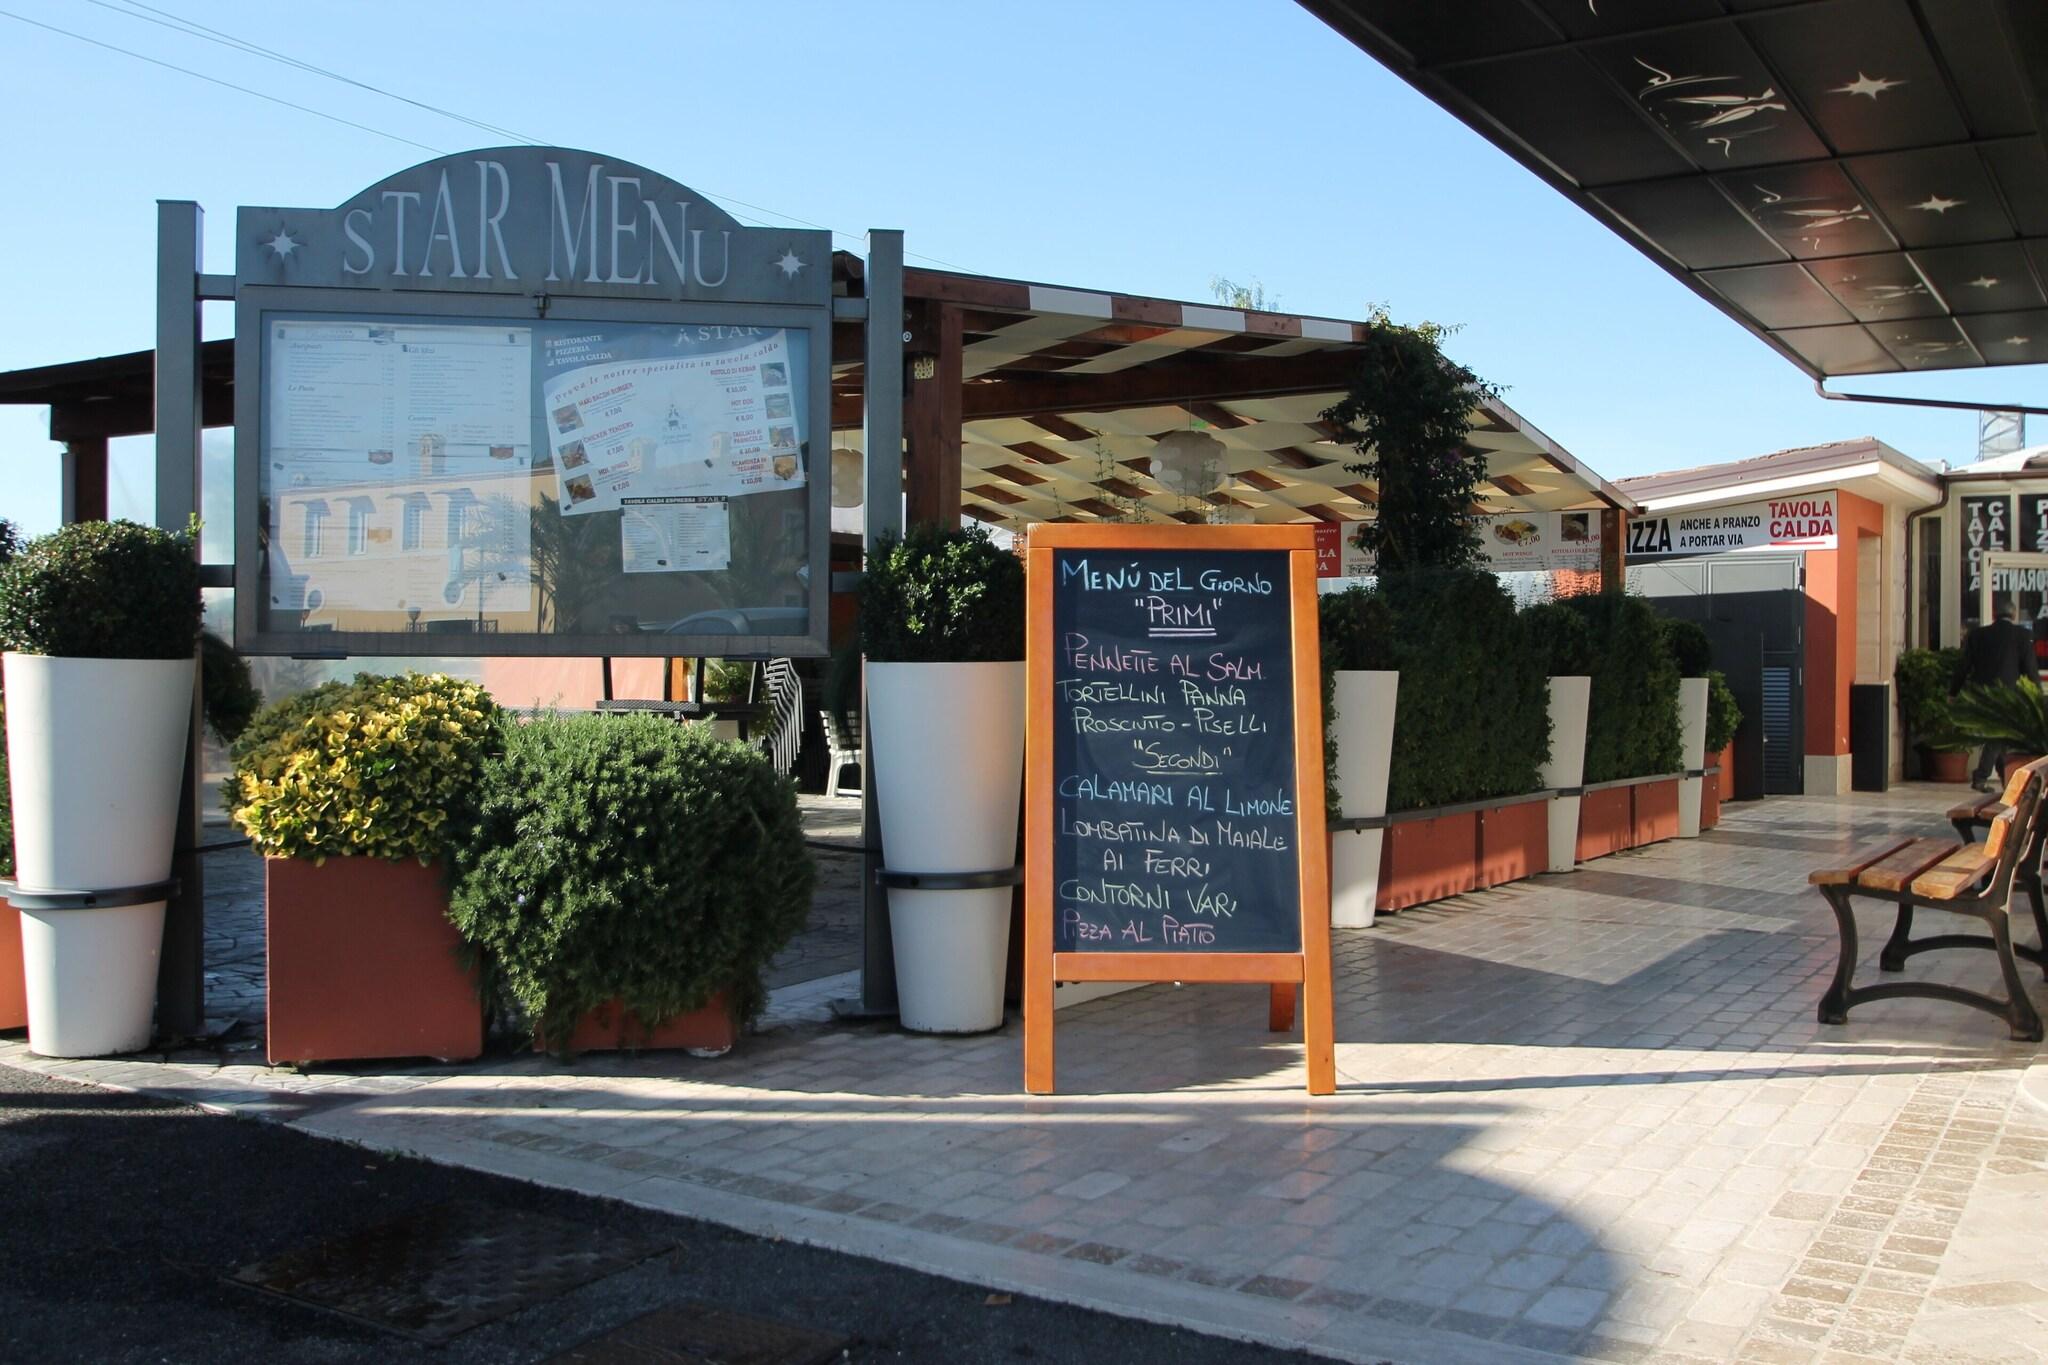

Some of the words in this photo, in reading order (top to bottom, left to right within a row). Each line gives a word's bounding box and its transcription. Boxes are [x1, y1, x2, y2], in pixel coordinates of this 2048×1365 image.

[343, 160, 519, 280] STAR
[545, 162, 731, 288] MENU
[553, 335, 602, 347] RISTORANTE
[555, 345, 591, 356] PIZZERIA
[556, 355, 585, 366] TAVOLA
[586, 352, 612, 362] CALDA
[604, 366, 637, 380] nostre
[1769, 501, 1832, 519] TAVOLA
[1626, 518, 1672, 553] IZZA
[1680, 518, 1711, 531] ANCHE
[1713, 518, 1720, 528] A
[1722, 515, 1761, 529] PRANZO
[1769, 520, 1834, 538] CALDA
[1680, 537, 1687, 548] A
[1689, 534, 1725, 547] PORTAR
[1727, 533, 1743, 546] VIA
[1988, 501, 2004, 551] CAL
[1318, 548, 1336, 558] LA
[1967, 502, 1984, 592] TAVOLA
[1149, 567, 1194, 592] DEL
[1200, 570, 1273, 595] GIORNO
[1064, 632, 1159, 674] PENNETTE
[1170, 654, 1200, 677] AL
[1056, 679, 1166, 704] TORTELLINI
[1179, 679, 1246, 706] PANNA
[1059, 773, 1174, 805] CALAMARI
[1187, 785, 1215, 811] AL
[1226, 788, 1293, 816] LIMONE
[1062, 808, 1181, 843] LOMBATINA
[1189, 825, 1209, 845] DI
[1217, 820, 1288, 851] MAIALE
[1103, 848, 1123, 871] AI
[1144, 849, 1210, 878] FERRI
[1059, 878, 1170, 909] CONTORNI
[1187, 883, 1238, 918] VARI
[1063, 908, 1113, 940] PIZZA
[1122, 919, 1152, 943] AL
[1163, 914, 1216, 944] PIATTO
